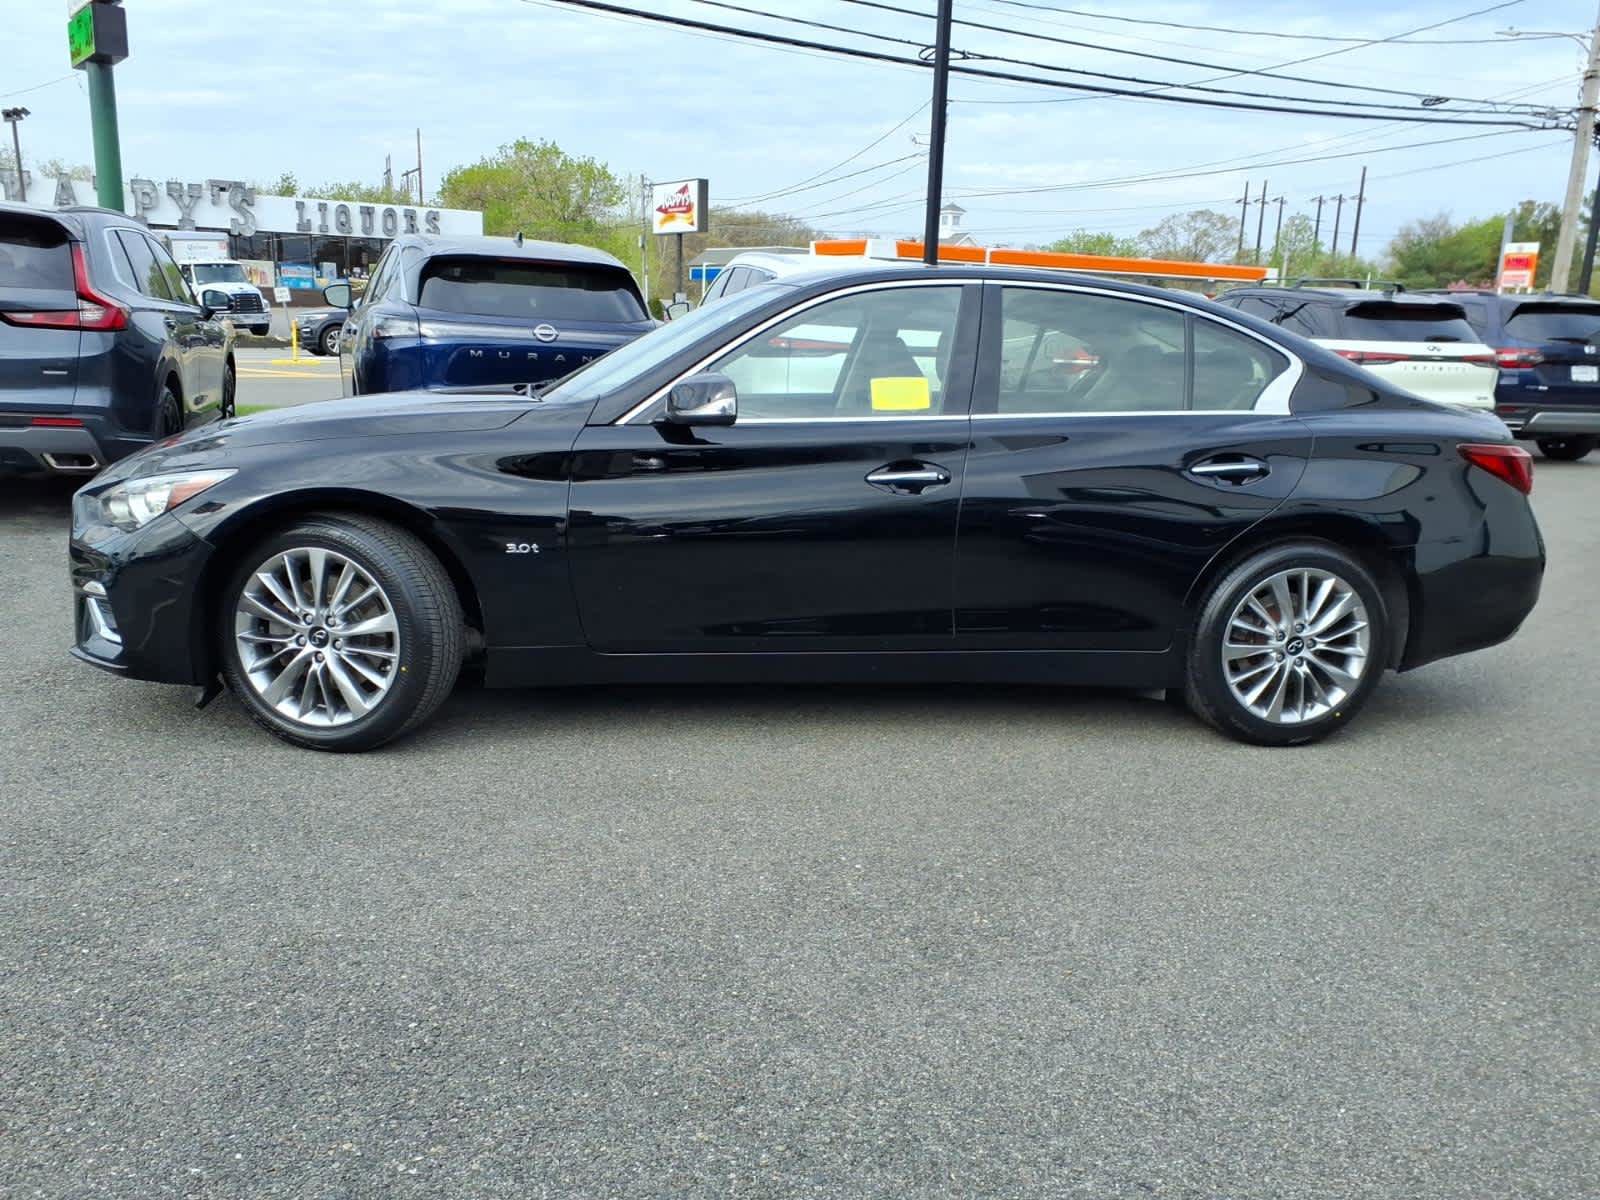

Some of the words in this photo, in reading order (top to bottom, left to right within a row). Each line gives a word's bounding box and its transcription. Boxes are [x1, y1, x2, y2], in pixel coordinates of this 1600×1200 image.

[0, 168, 256, 236] APY'S
[296, 201, 440, 237] LIQUORS
[505, 543, 539, 553] 3.0t
